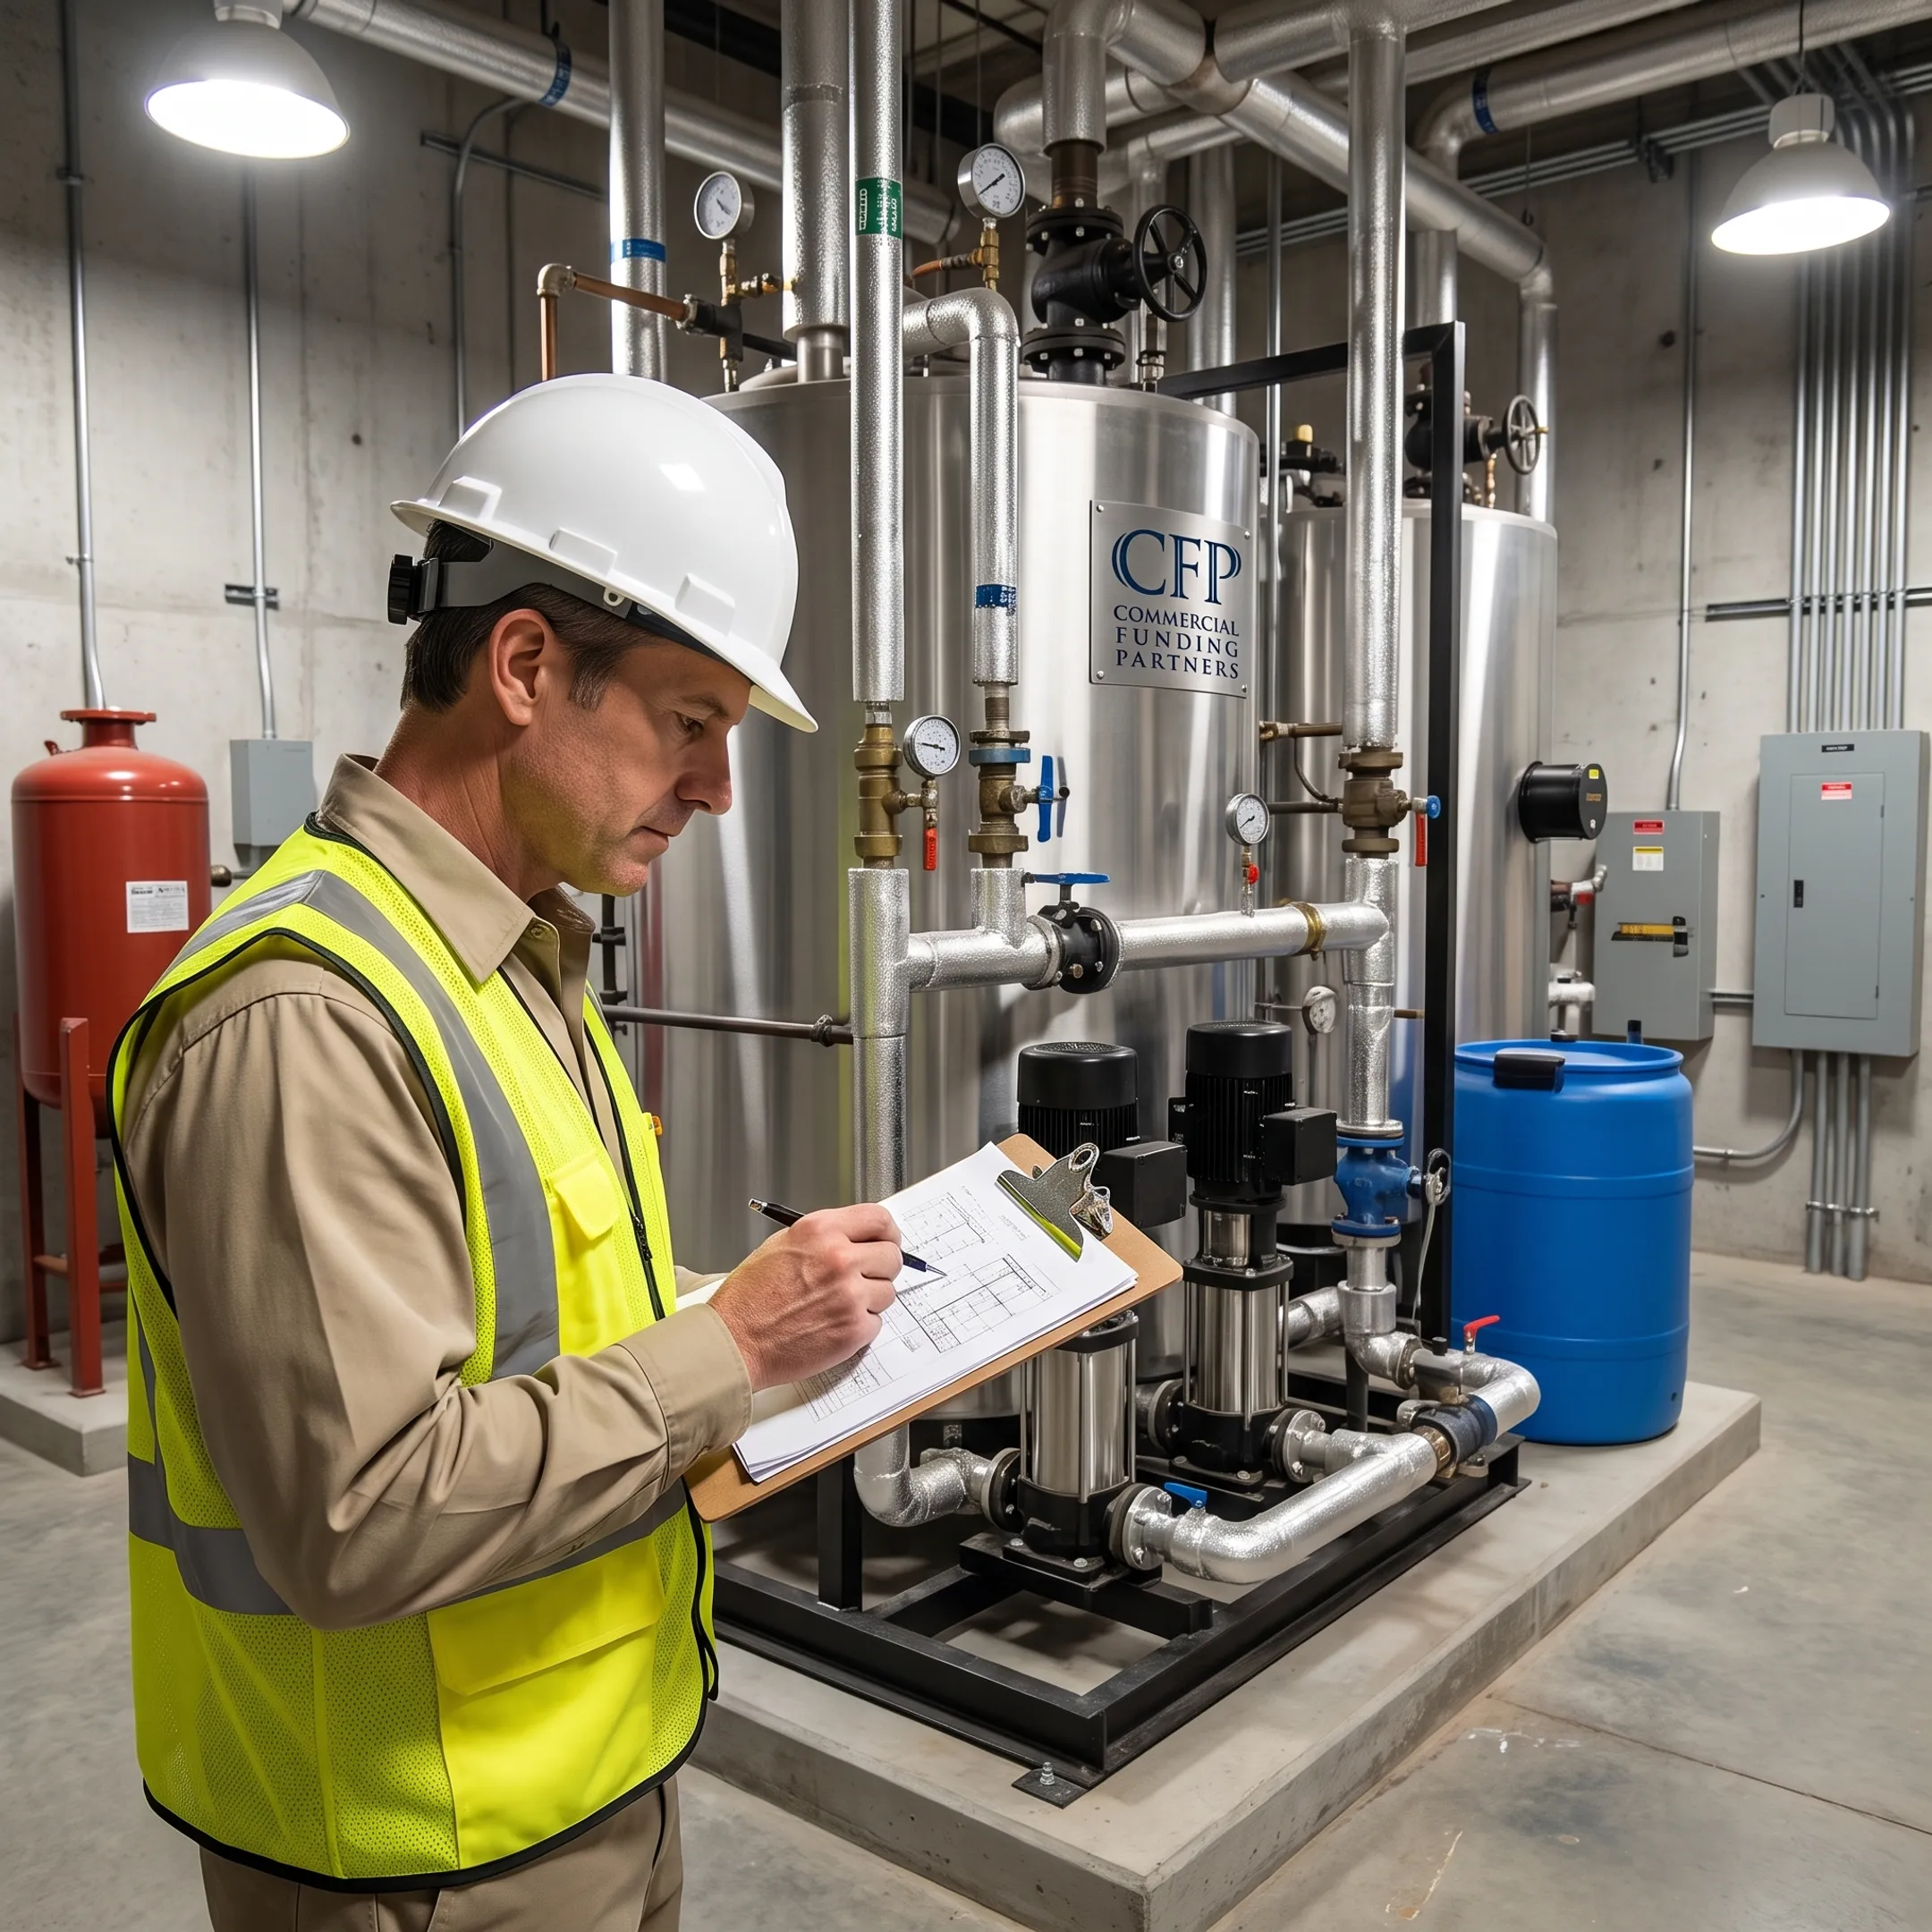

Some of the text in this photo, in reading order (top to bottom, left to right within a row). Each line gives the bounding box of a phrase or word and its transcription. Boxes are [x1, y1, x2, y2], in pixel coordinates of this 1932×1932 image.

[1111, 529, 1241, 605] CFP
[1114, 605, 1240, 636] COMMERCIAL
[1115, 627, 1238, 657] FUNDING
[1115, 649, 1238, 679] PARTNERS
